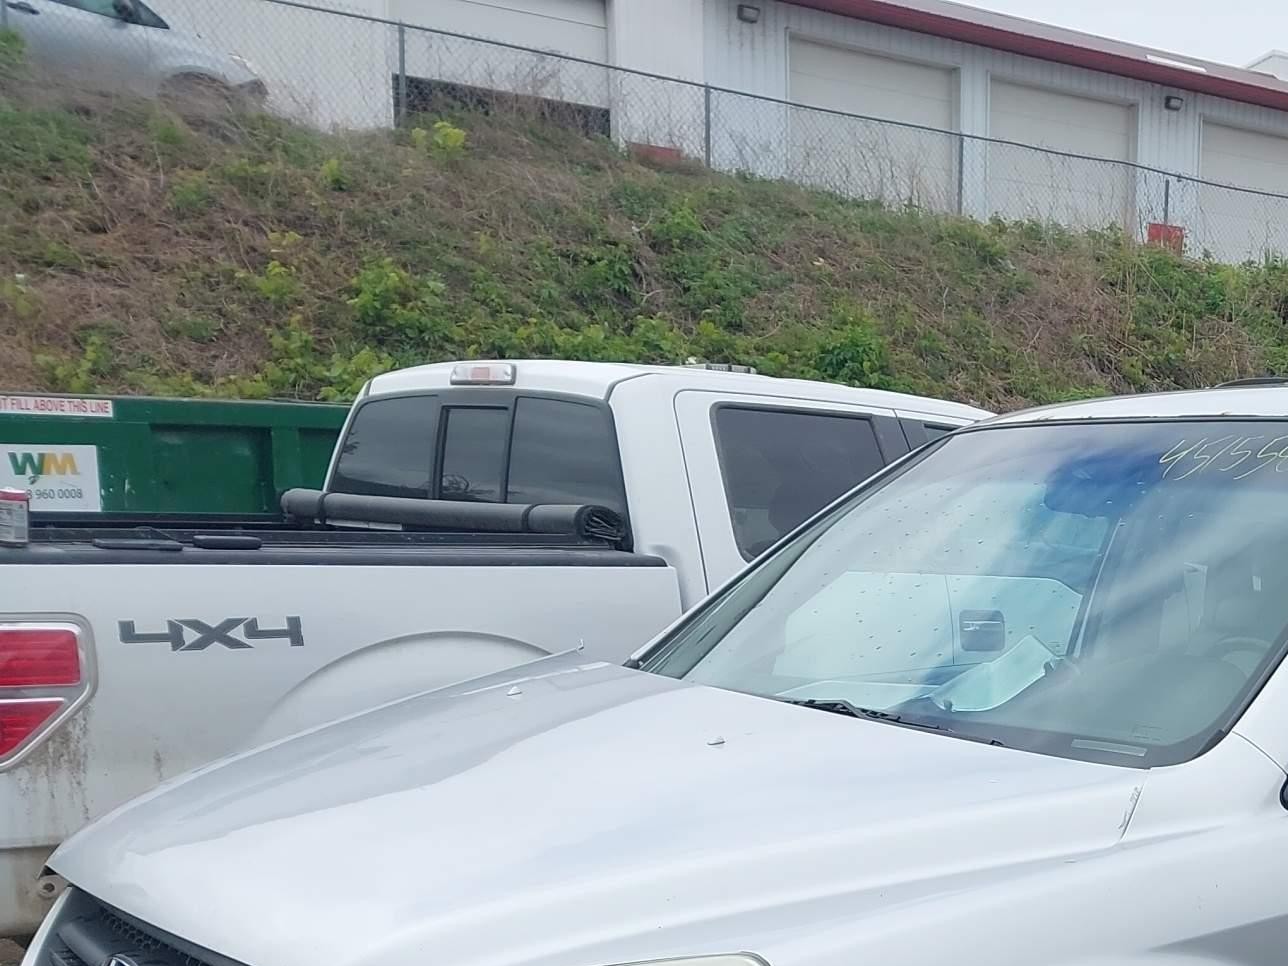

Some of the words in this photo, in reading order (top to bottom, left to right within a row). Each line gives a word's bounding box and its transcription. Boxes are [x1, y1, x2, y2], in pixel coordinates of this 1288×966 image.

[11, 398, 32, 410] FILL
[33, 399, 65, 411] ABOVE
[67, 400, 88, 413] THIS
[90, 401, 110, 413] LINE
[8, 452, 79, 475] WM
